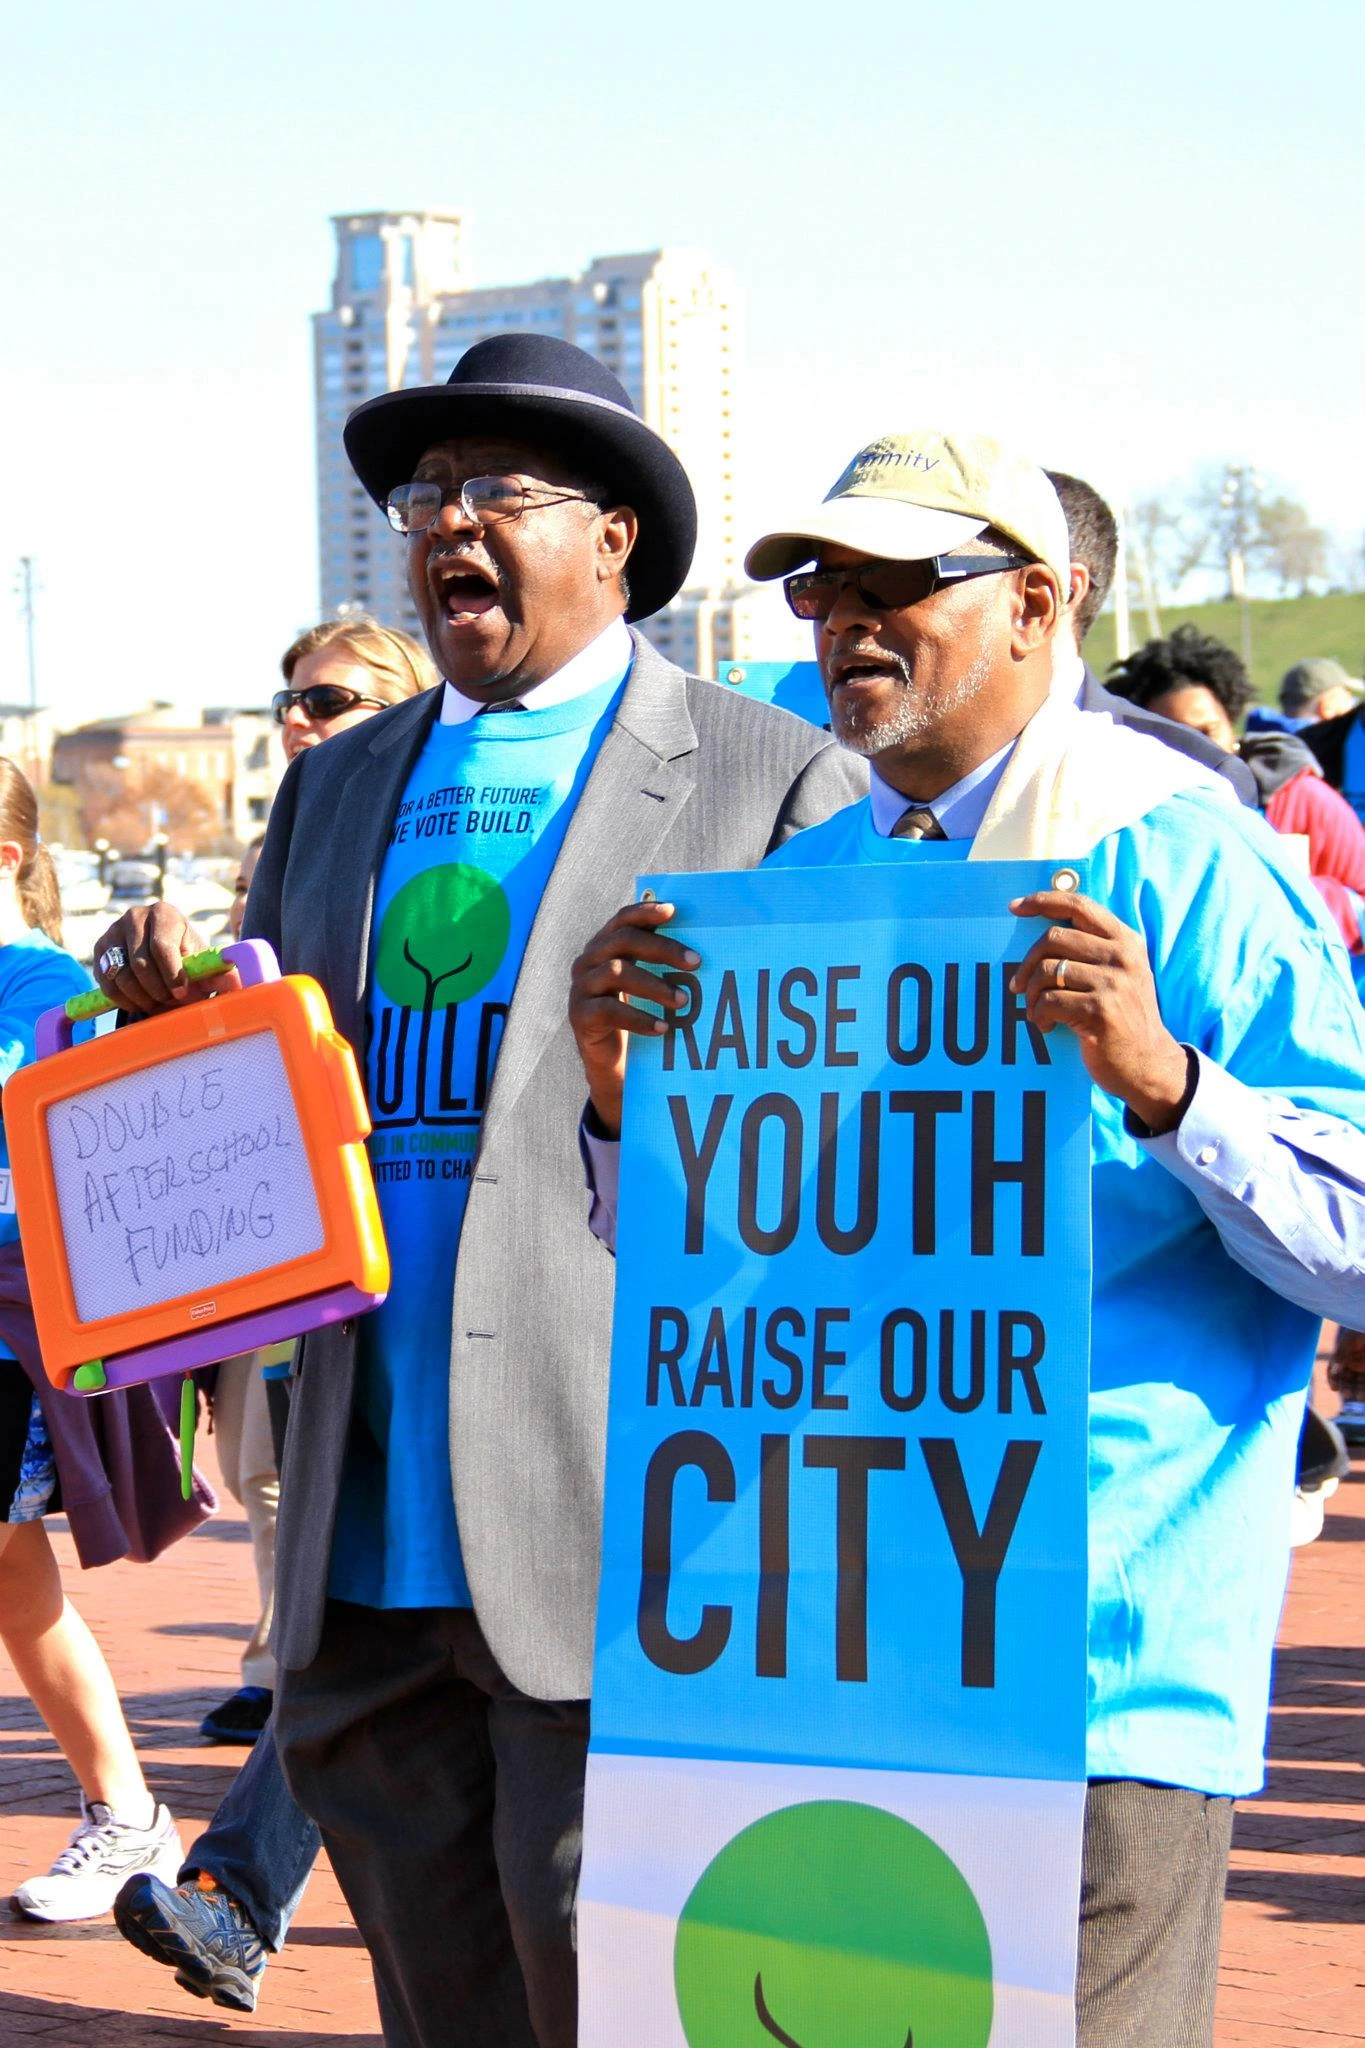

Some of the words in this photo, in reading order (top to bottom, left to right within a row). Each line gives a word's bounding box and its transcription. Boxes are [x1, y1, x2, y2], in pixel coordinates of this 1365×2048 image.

[398, 800, 415, 817] OR
[415, 795, 424, 813] A
[426, 786, 475, 810] BETTER
[480, 786, 542, 806] FUTURE,
[415, 811, 460, 840] VOTE
[465, 810, 535, 834] BUILD.
[365, 1002, 510, 1115] UILD
[661, 964, 861, 1072] RAISE
[886, 962, 1052, 1067] OUR
[68, 1068, 224, 1160] DOUBLE
[374, 1160, 411, 1183] ITTED
[416, 1159, 436, 1179] TO
[666, 1089, 1047, 1257] YOUTH
[125, 1180, 276, 1286] FUNDING
[645, 1306, 851, 1410] RAISE
[879, 1307, 1048, 1416] OUR
[636, 1429, 1044, 1689] CITY
